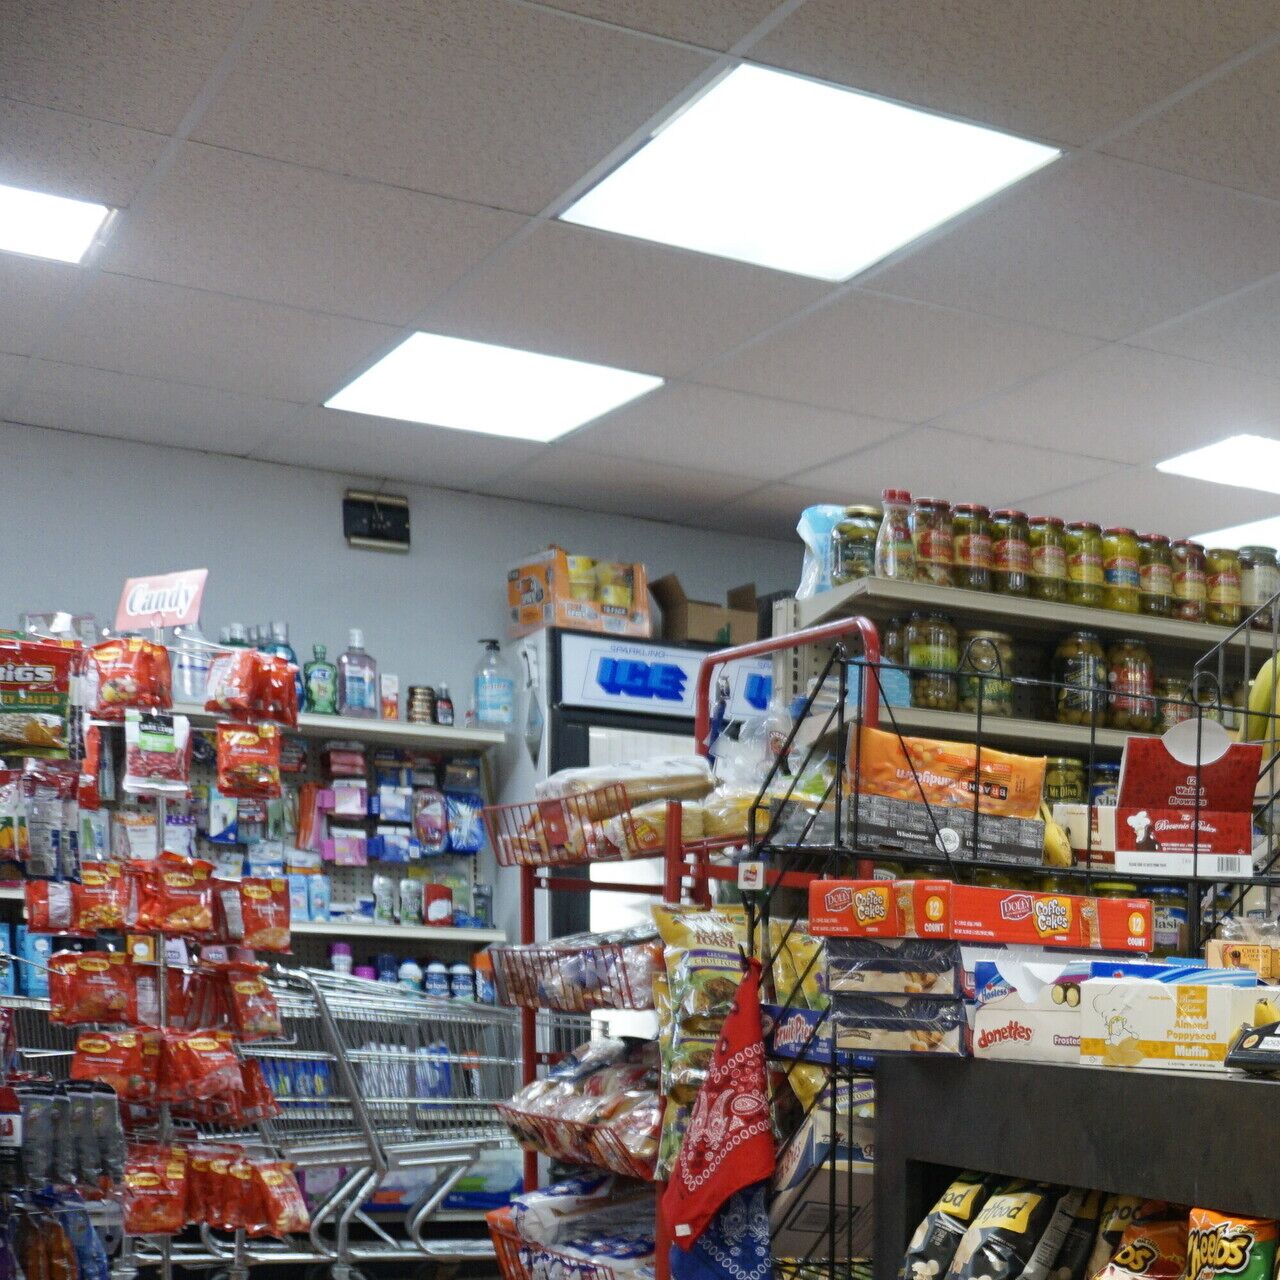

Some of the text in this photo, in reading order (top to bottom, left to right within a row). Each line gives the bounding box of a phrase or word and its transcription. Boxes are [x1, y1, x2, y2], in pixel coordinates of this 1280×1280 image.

[128, 582, 198, 617] Candy
[609, 643, 667, 658] SPARKLING
[596, 656, 688, 702] ICE
[1060, 784, 1078, 798] Olive
[825, 889, 853, 906] DOLLY
[853, 888, 885, 909] Coffee
[1004, 897, 1031, 914] DOLLY
[857, 904, 887, 920] Cakes
[928, 899, 941, 916] 12
[1035, 903, 1068, 921] Coffee
[924, 923, 945, 933] COUNT
[1036, 915, 1070, 932] Cakes
[1130, 916, 1143, 932] 12
[1127, 938, 1147, 948] COUNT
[981, 986, 1011, 1001] Hostess
[1173, 1019, 1209, 1030] Almond
[977, 1021, 1033, 1050] donettes
[1053, 1034, 1080, 1046] Frosted
[1166, 1029, 1217, 1041] Poppyseed
[1174, 1044, 1210, 1058] Muffin
